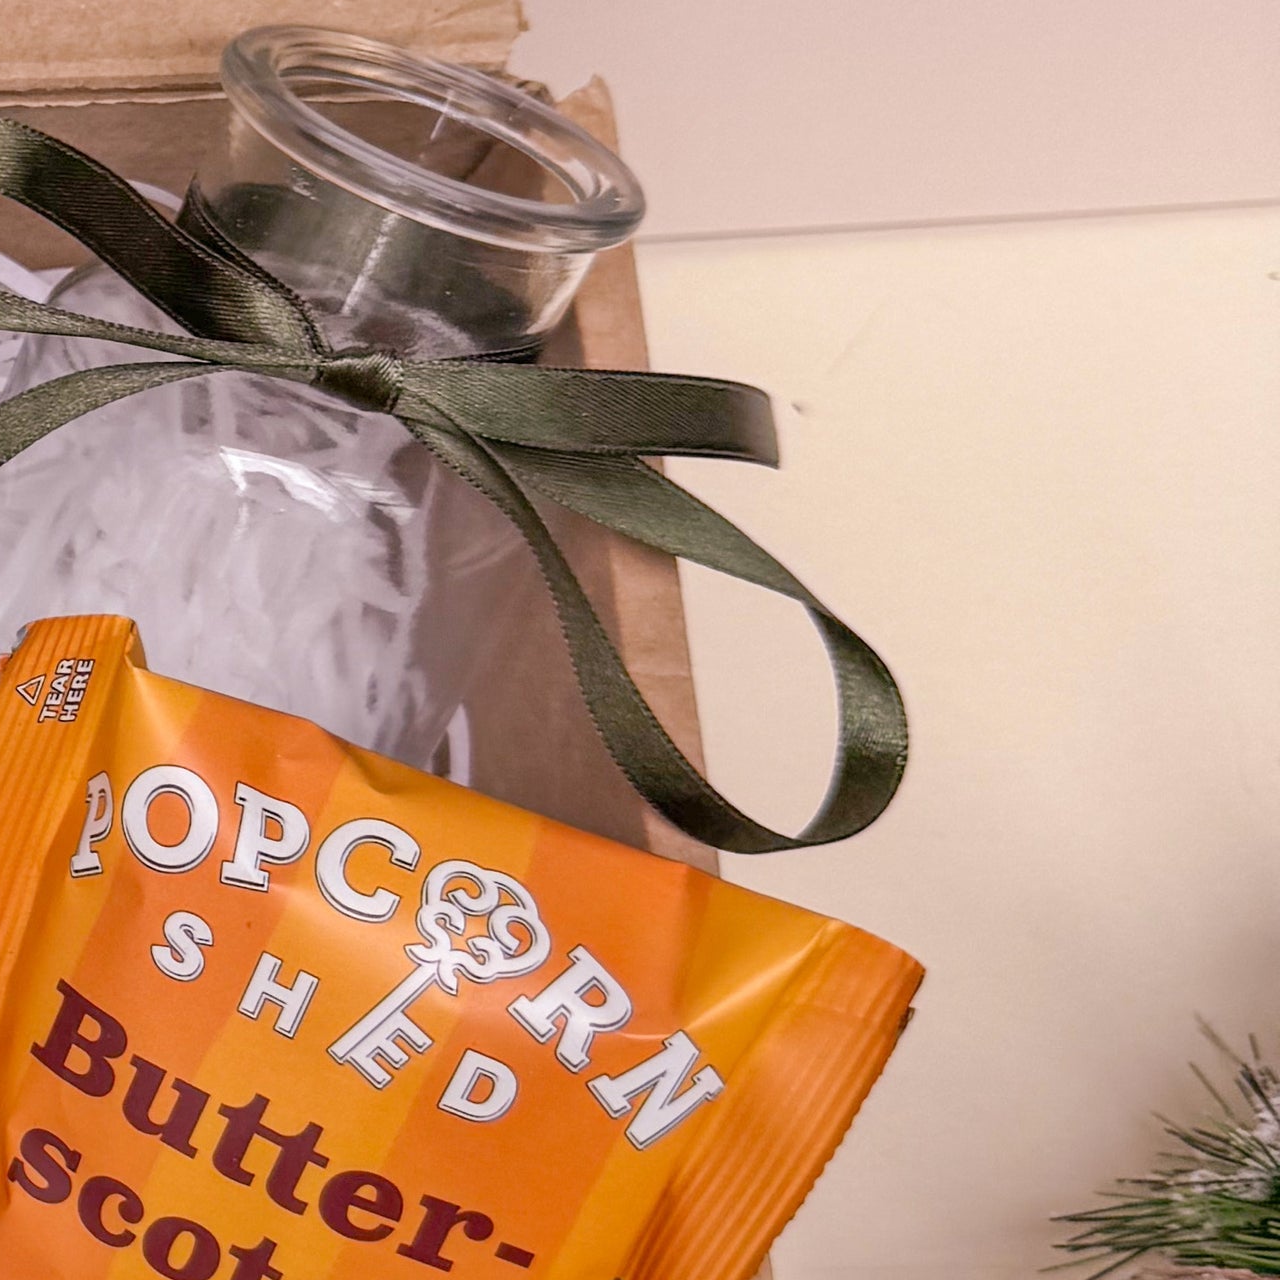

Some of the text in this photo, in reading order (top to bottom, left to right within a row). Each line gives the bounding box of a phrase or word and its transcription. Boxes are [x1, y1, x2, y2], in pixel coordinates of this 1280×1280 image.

[37, 658, 76, 723] TEAR
[58, 659, 95, 722] HERE
[69, 764, 726, 1151] POPCORN
[150, 910, 518, 1123] SHED
[29, 977, 536, 1273] Butter-
